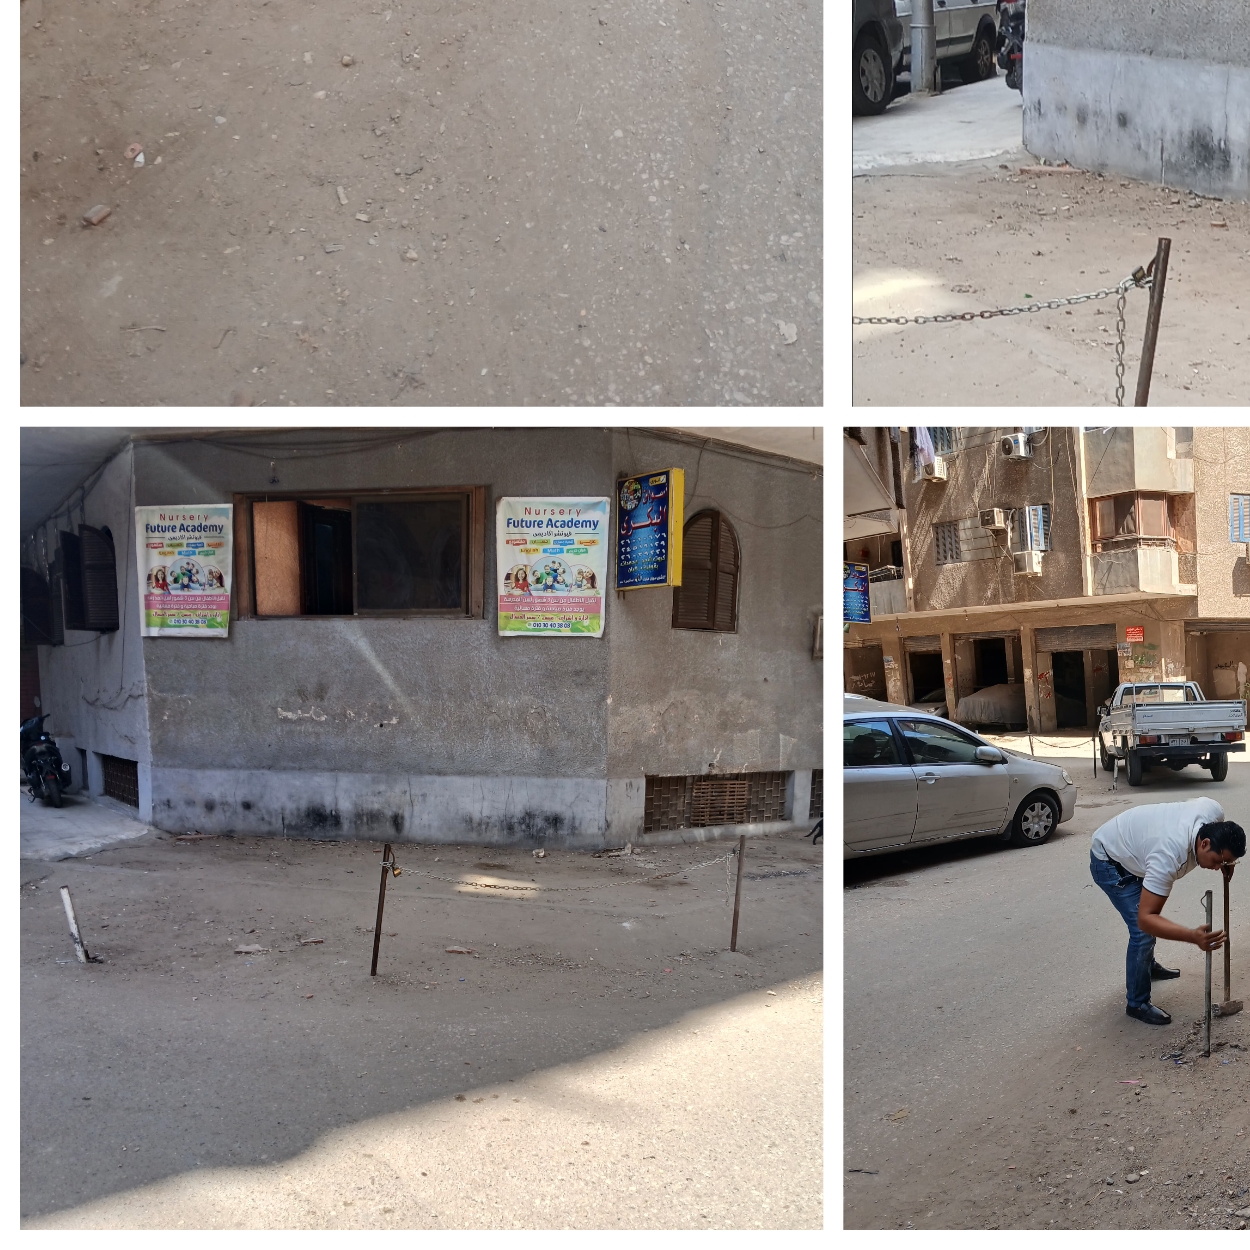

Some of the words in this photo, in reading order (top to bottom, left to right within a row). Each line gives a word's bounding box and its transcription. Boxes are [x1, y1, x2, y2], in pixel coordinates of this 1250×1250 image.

[524, 507, 582, 517] Nursery
[160, 513, 209, 522] Nursery
[145, 523, 177, 533] Future
[179, 523, 224, 534] Academy
[506, 518, 544, 529] Future
[546, 518, 600, 531] Academy
